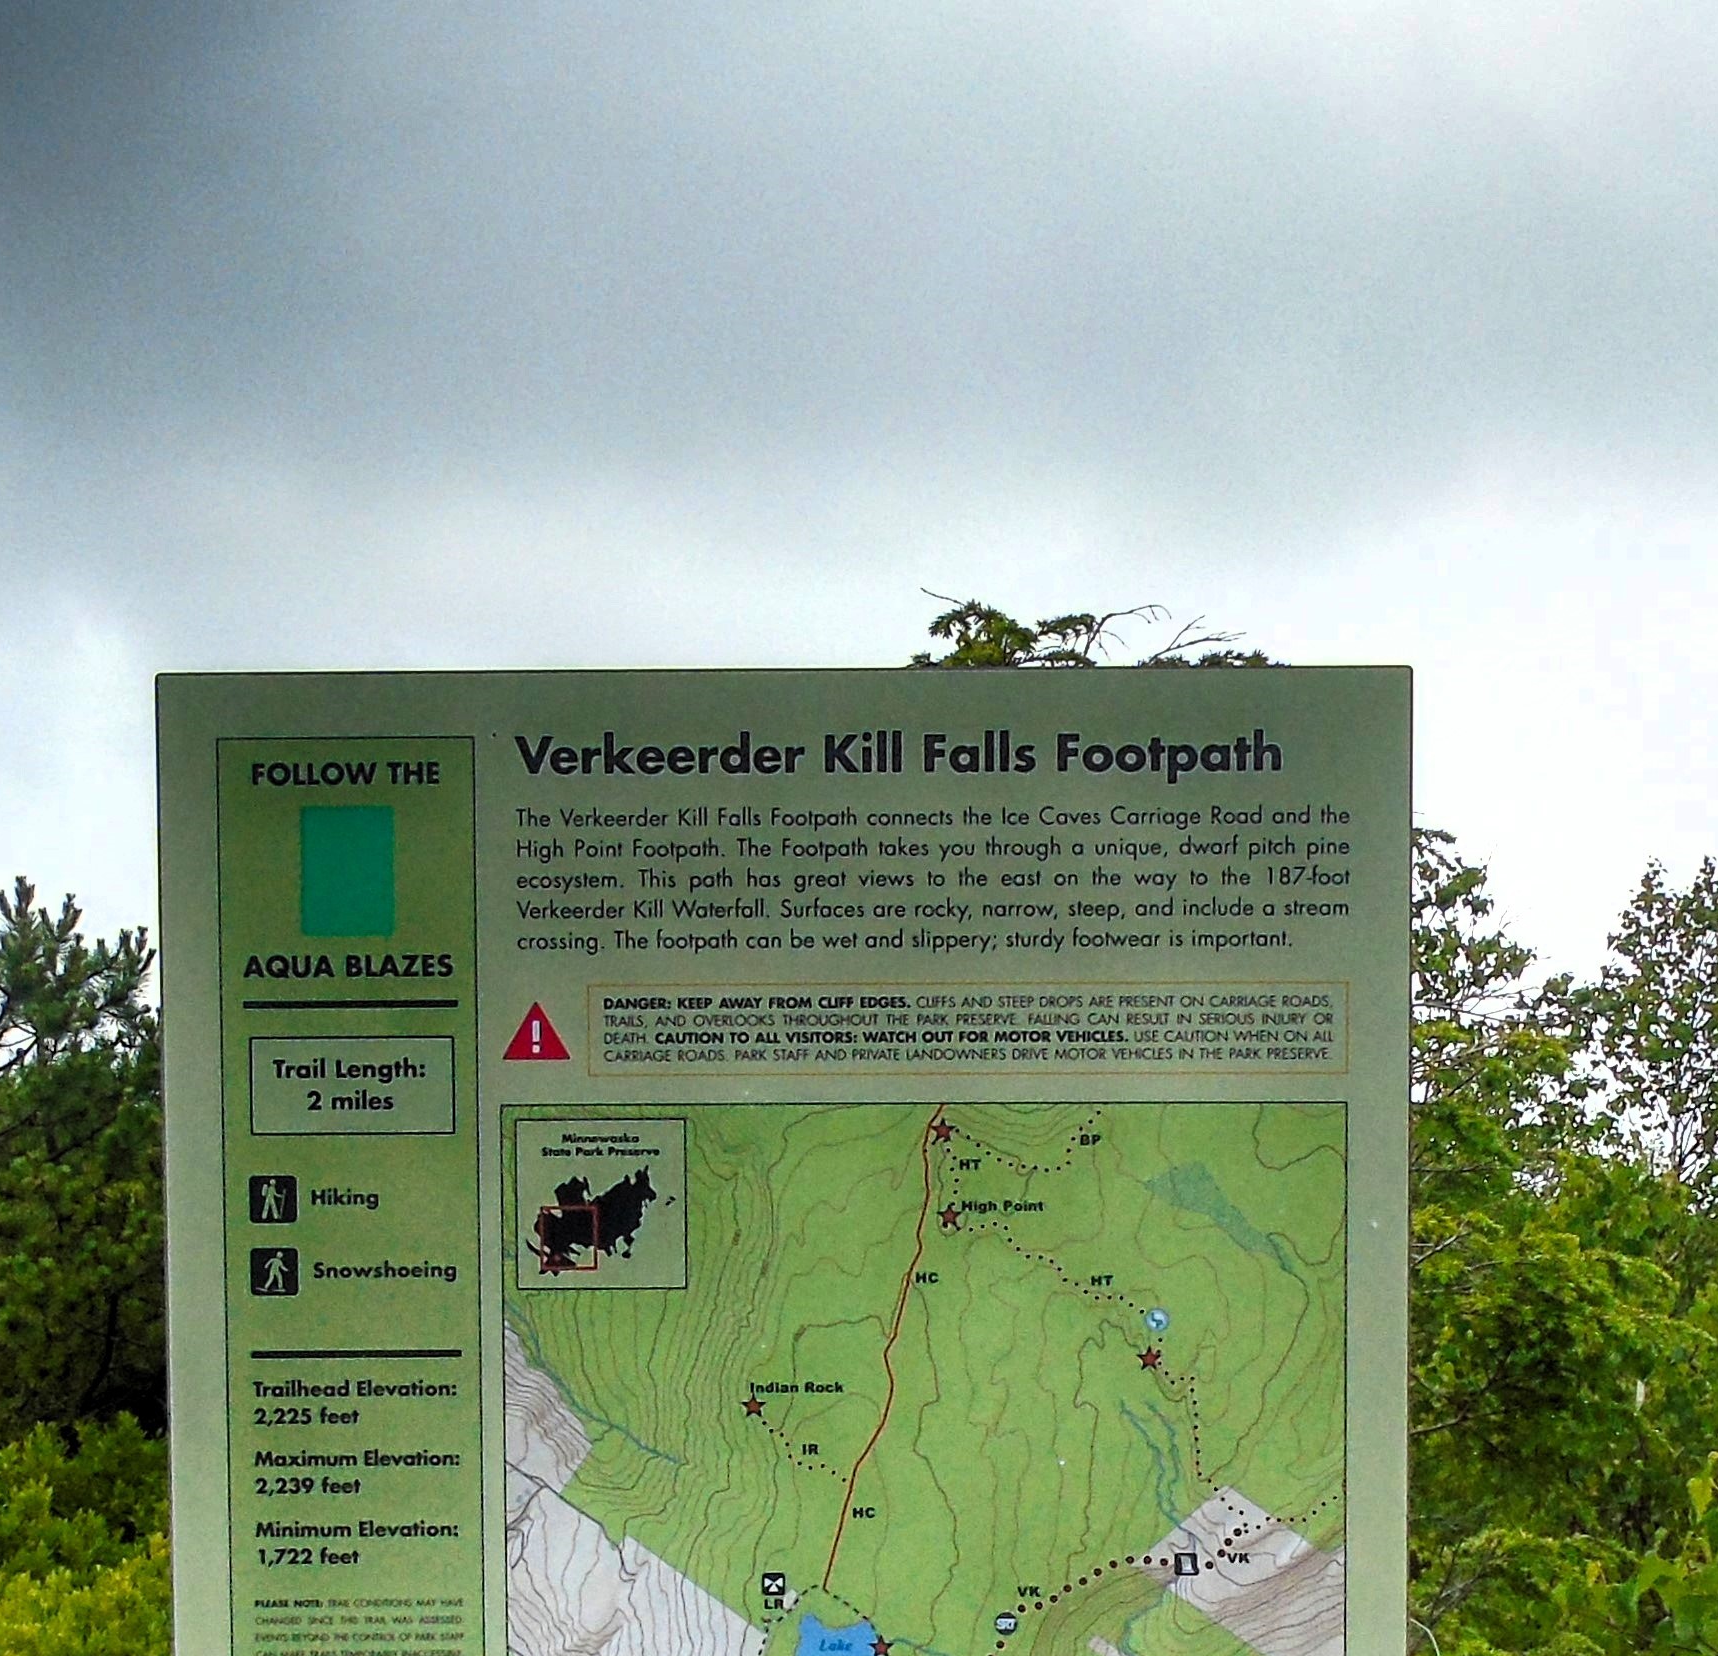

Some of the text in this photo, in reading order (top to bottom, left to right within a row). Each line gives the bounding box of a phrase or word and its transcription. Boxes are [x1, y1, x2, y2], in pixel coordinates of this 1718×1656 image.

[514, 728, 1281, 784] Verkeerder Kill Falls Footpath
[251, 761, 440, 786] FOLLOW THE
[515, 804, 1350, 832] The Verkeerder Kill Falls Footpath connects the Ice Caves Carriage Road and the
[516, 834, 1350, 864] High Point Footpath. The Footpath takes you through a unique, dwarf pitch pine
[516, 864, 1350, 894] ecosystem. This path has great views to the east on the way to the 187-foot
[516, 896, 1349, 924] Verkeerder Kill Waterfall. Surfaces are rocky, narrow, steep, and include a stream
[517, 926, 1292, 956] crossing. The footpath can be wet and slippery; sturdy footwear is important.
[243, 954, 453, 979] AQUA BLAZES
[603, 996, 911, 1010] DANGER: KEEP AWAY FROM CLIFF EDGES.
[272, 1056, 426, 1084] Trail Length:
[307, 1089, 394, 1111] 2 miles
[1079, 1134, 1102, 1146] BP
[959, 1159, 982, 1171] HT
[311, 1187, 379, 1210] Hiking
[961, 1200, 1043, 1214] High Point
[313, 1260, 457, 1282] Snowshoeing
[915, 1272, 939, 1284] HC
[1091, 1275, 1114, 1286] HT
[252, 1379, 457, 1398] Trailhead Elevation:
[750, 1381, 843, 1396] Indian Rock
[253, 1406, 360, 1427] 2,225 feet
[254, 1448, 460, 1467] Maximum Elevation:
[802, 1444, 819, 1456] IR
[255, 1476, 361, 1497] 2,239 feet
[852, 1507, 875, 1519] HC
[255, 1520, 459, 1538] Minimum Elevation:
[258, 1546, 359, 1568] 1,722 feet
[1227, 1553, 1250, 1565] VK
[1017, 1586, 1041, 1598] VK
[764, 1598, 784, 1610] LR
[819, 1638, 853, 1652] Lake
